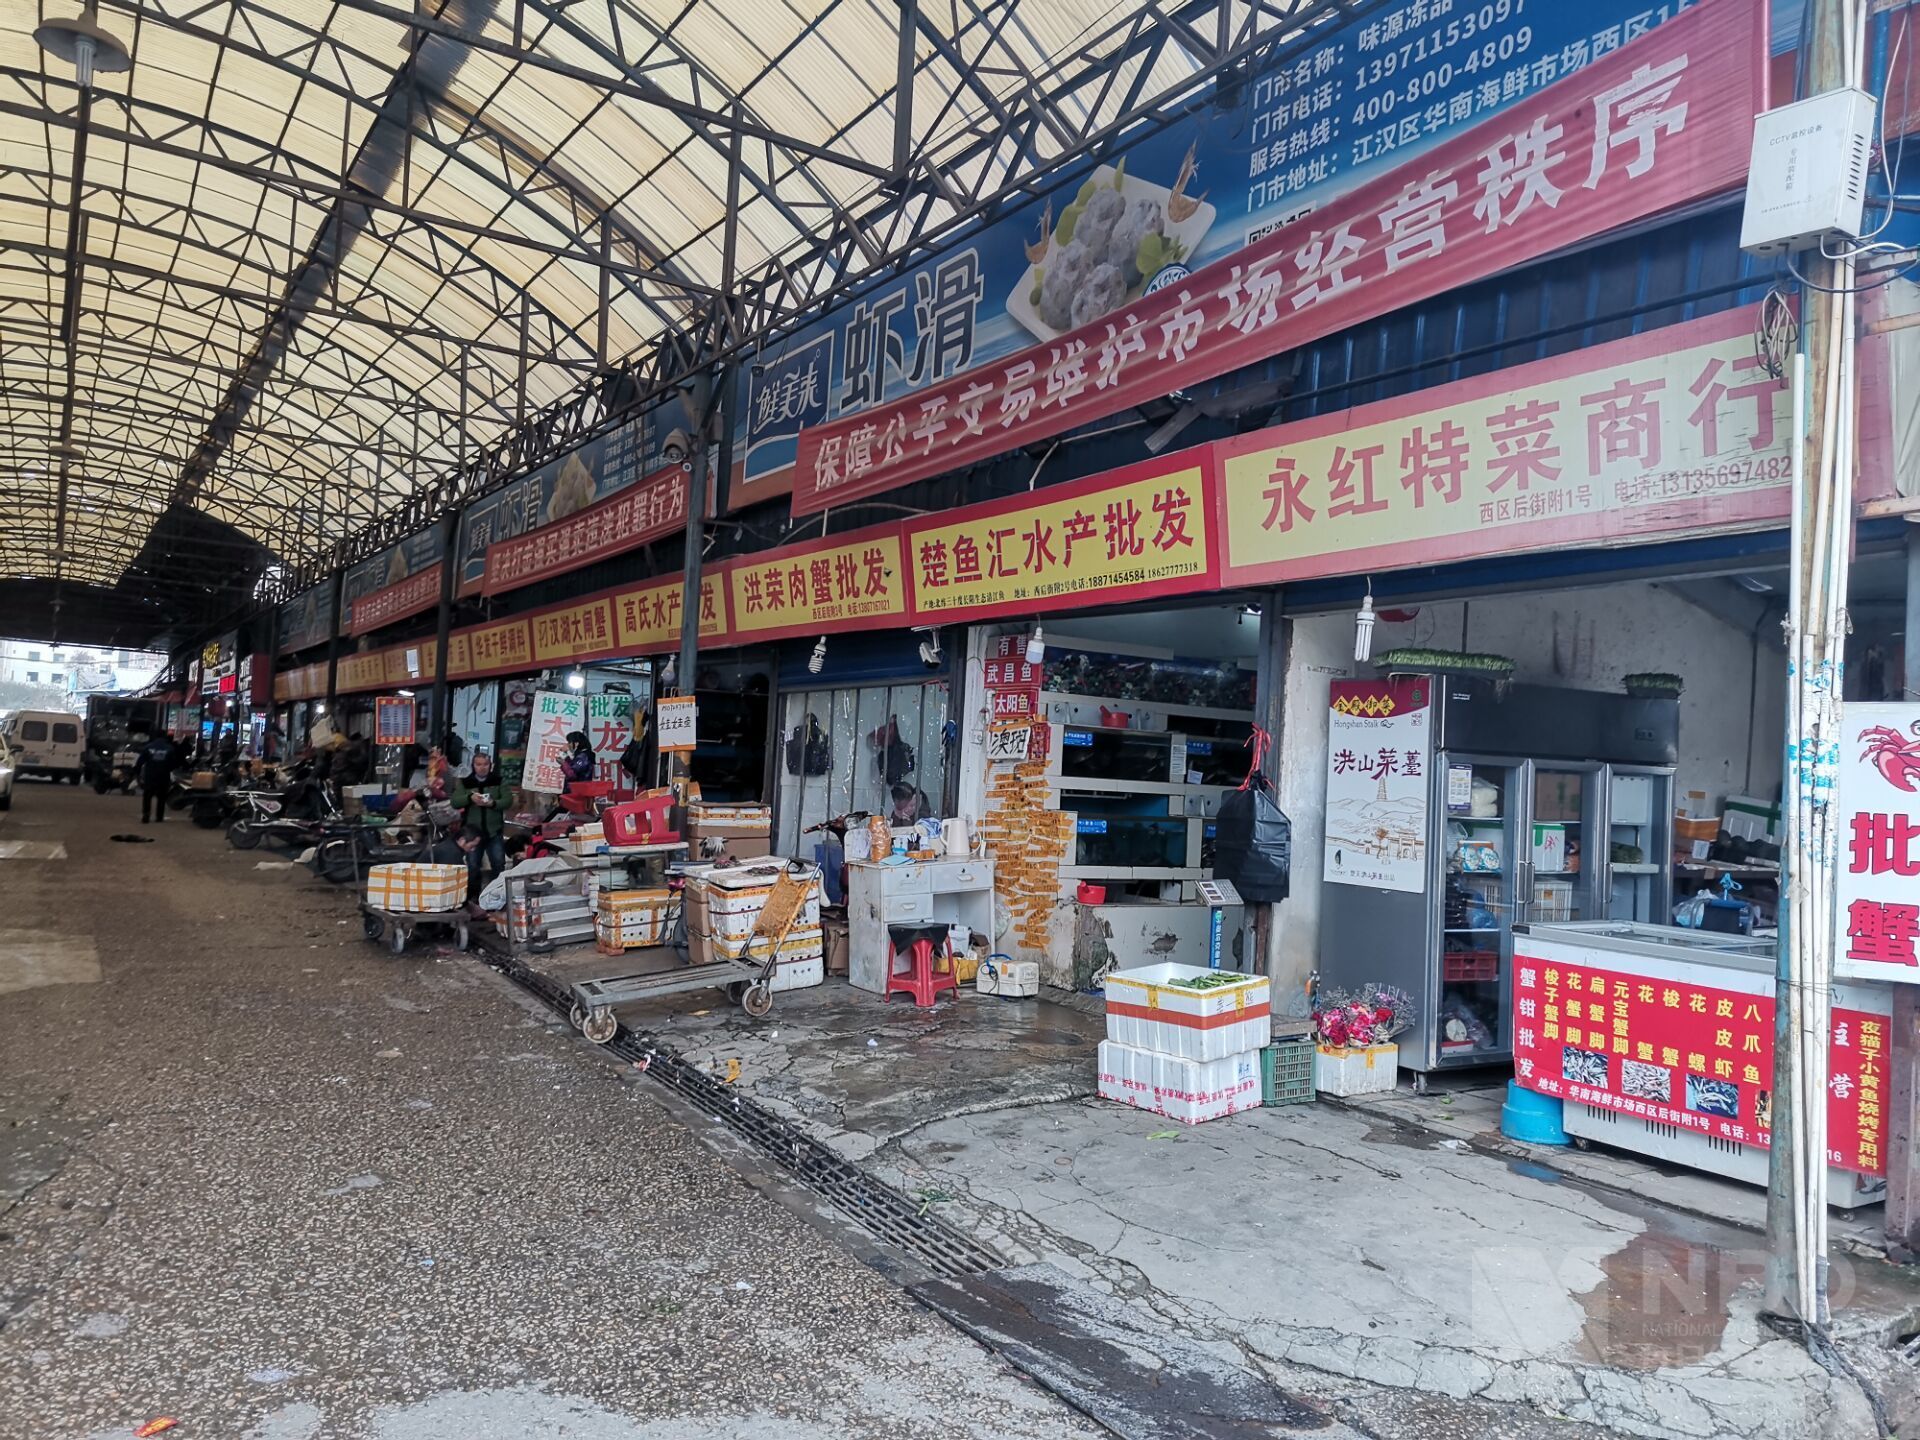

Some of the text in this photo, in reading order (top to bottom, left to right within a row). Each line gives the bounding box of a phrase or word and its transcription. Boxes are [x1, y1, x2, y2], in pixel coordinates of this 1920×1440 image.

[839, 247, 984, 411] 虾滑
[1261, 352, 1790, 533] 永红特菜商行
[919, 486, 1194, 588] 楚鱼汇水产批发
[1479, 485, 1592, 523] 西区后街附1号
[624, 582, 717, 633] 高氏水产发
[743, 547, 887, 613] 洪荣肉蟹批发
[987, 662, 1032, 684] 武昌鱼
[995, 693, 1029, 714] 太阳鱼
[541, 696, 580, 718] 批发
[590, 696, 632, 719] 批发
[1847, 899, 1919, 966] 蟹
[1519, 967, 1537, 1079] 蟹钳批发
[1565, 971, 1583, 1045] 花蟹脚
